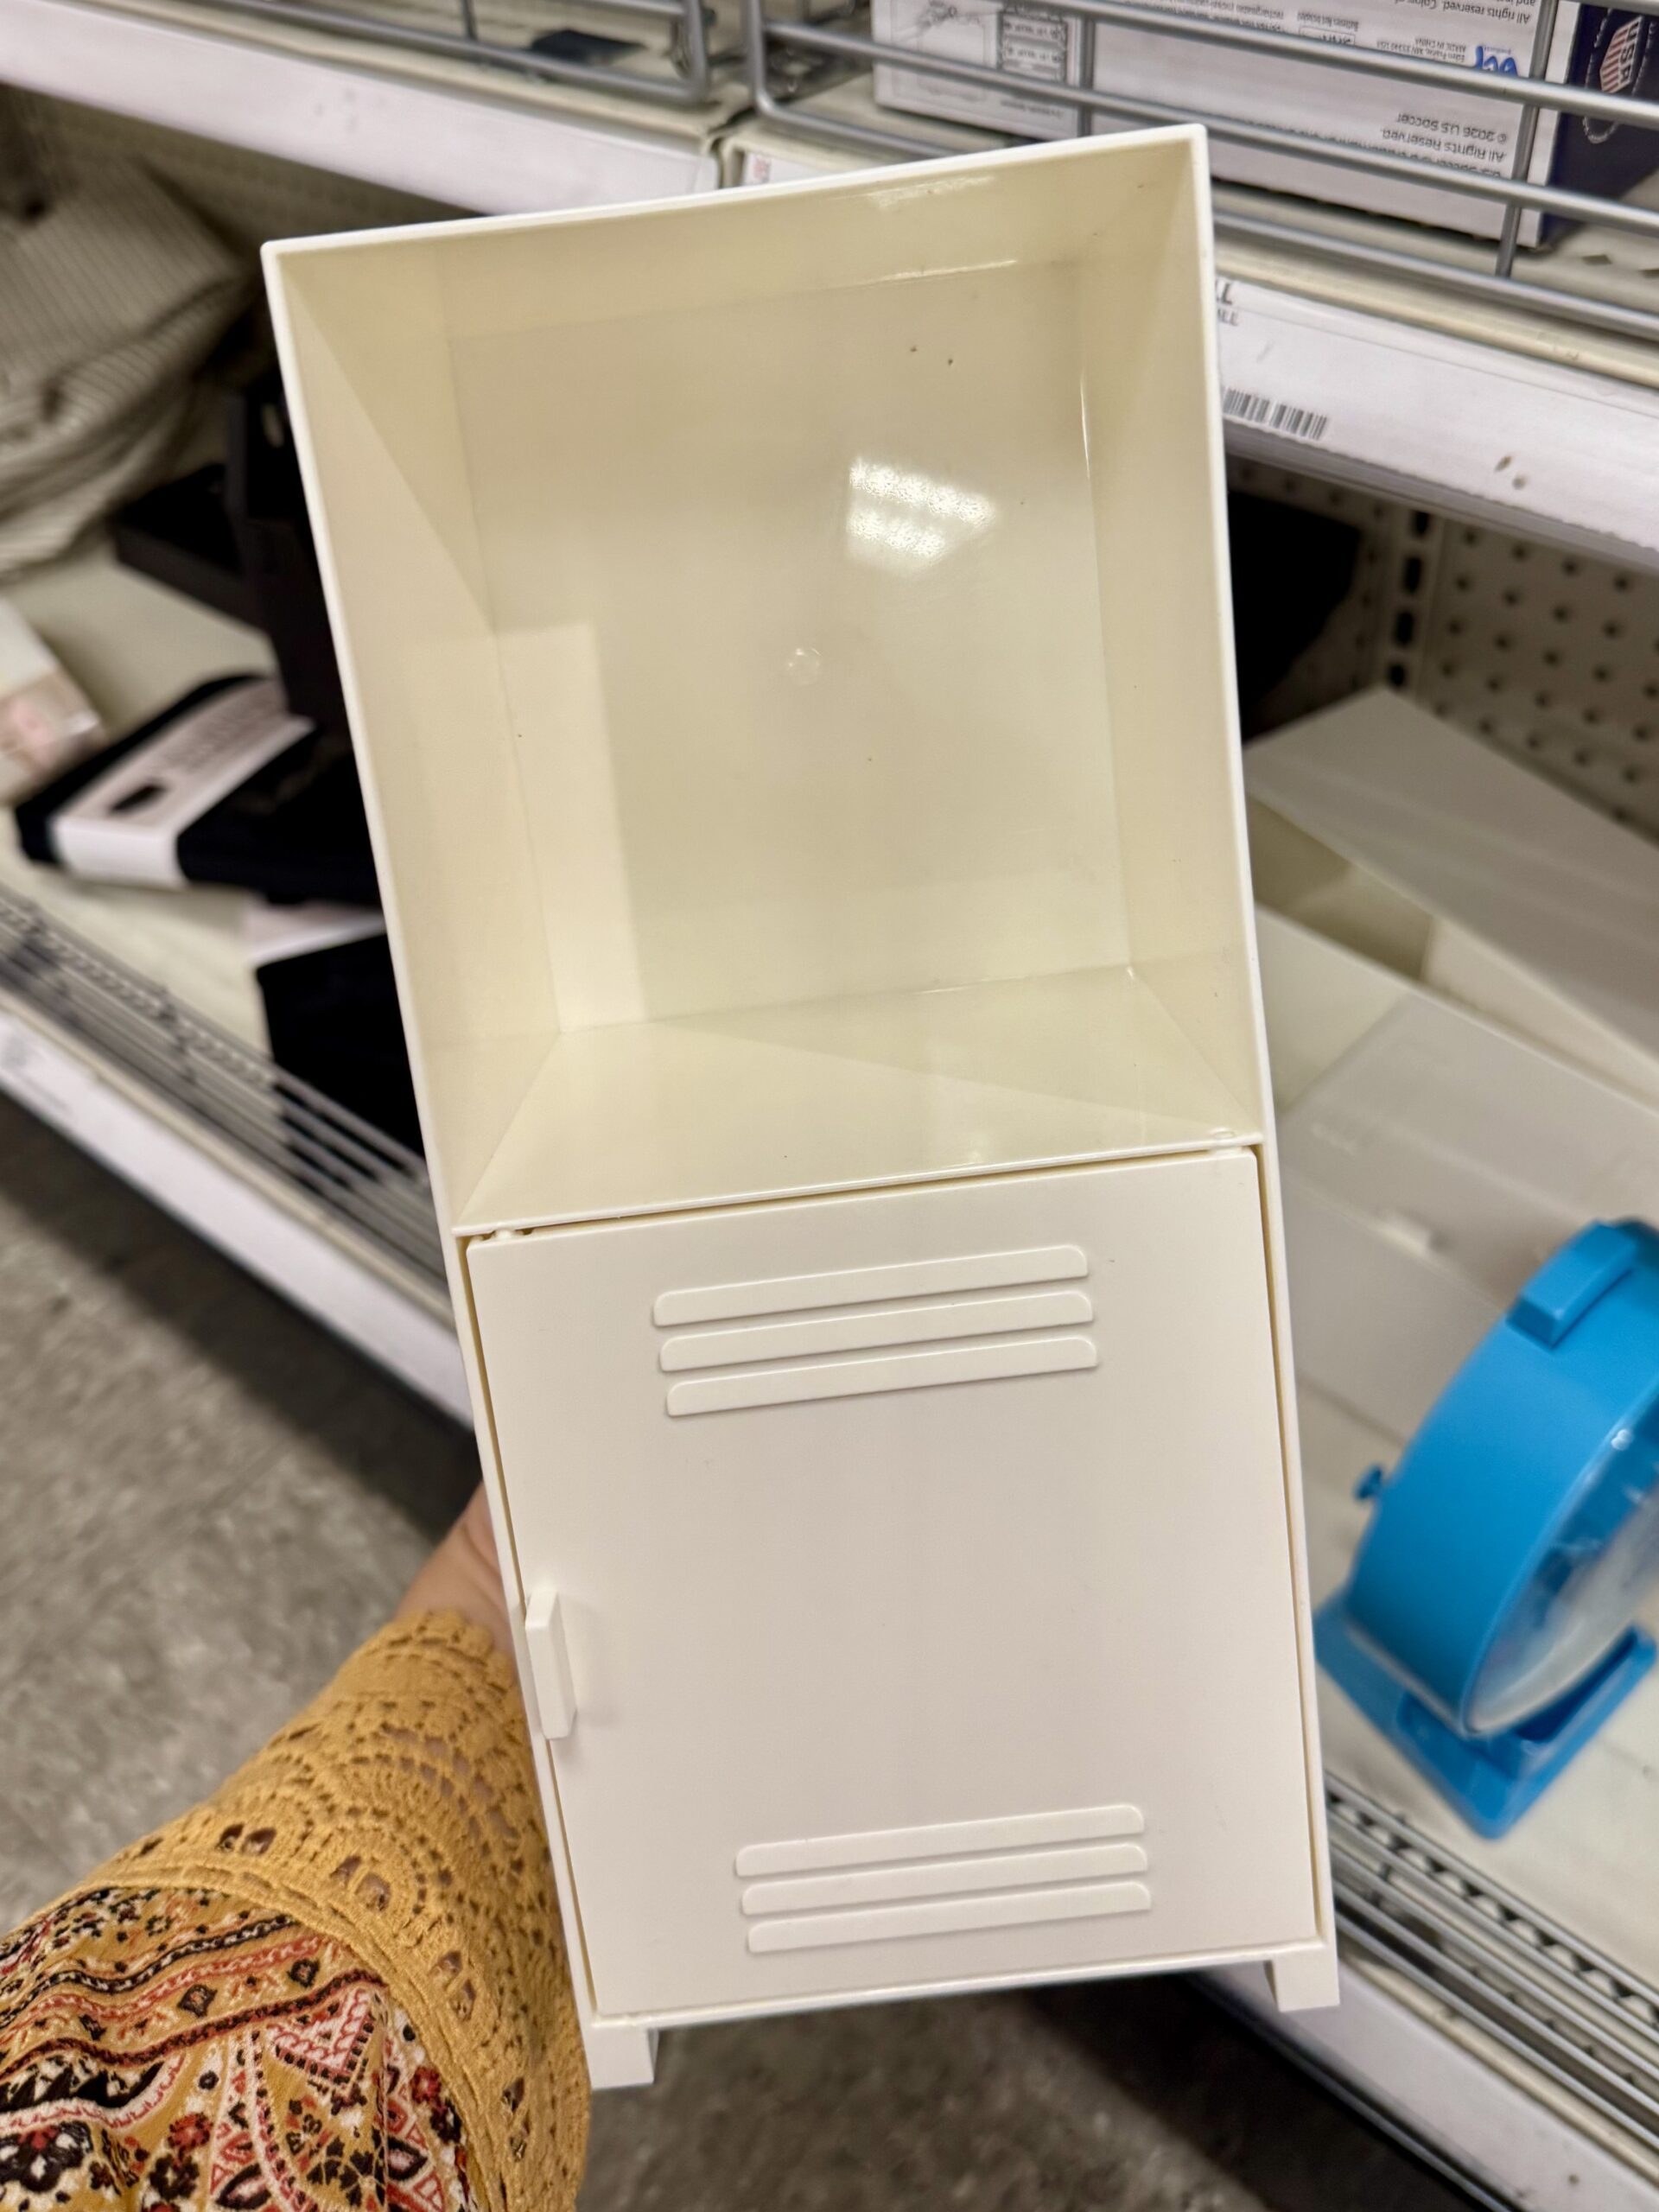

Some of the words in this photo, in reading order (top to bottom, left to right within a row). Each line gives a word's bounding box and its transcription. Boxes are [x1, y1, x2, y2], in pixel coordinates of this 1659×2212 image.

[1441, 1, 1484, 16] reserved.
[1487, 7, 1516, 22] rights
[1516, 13, 1530, 25] All
[1395, 114, 1440, 131] Soccer
[1463, 127, 1496, 143] 2026
[1444, 142, 1486, 159] Rights
[1488, 150, 1504, 163] All
